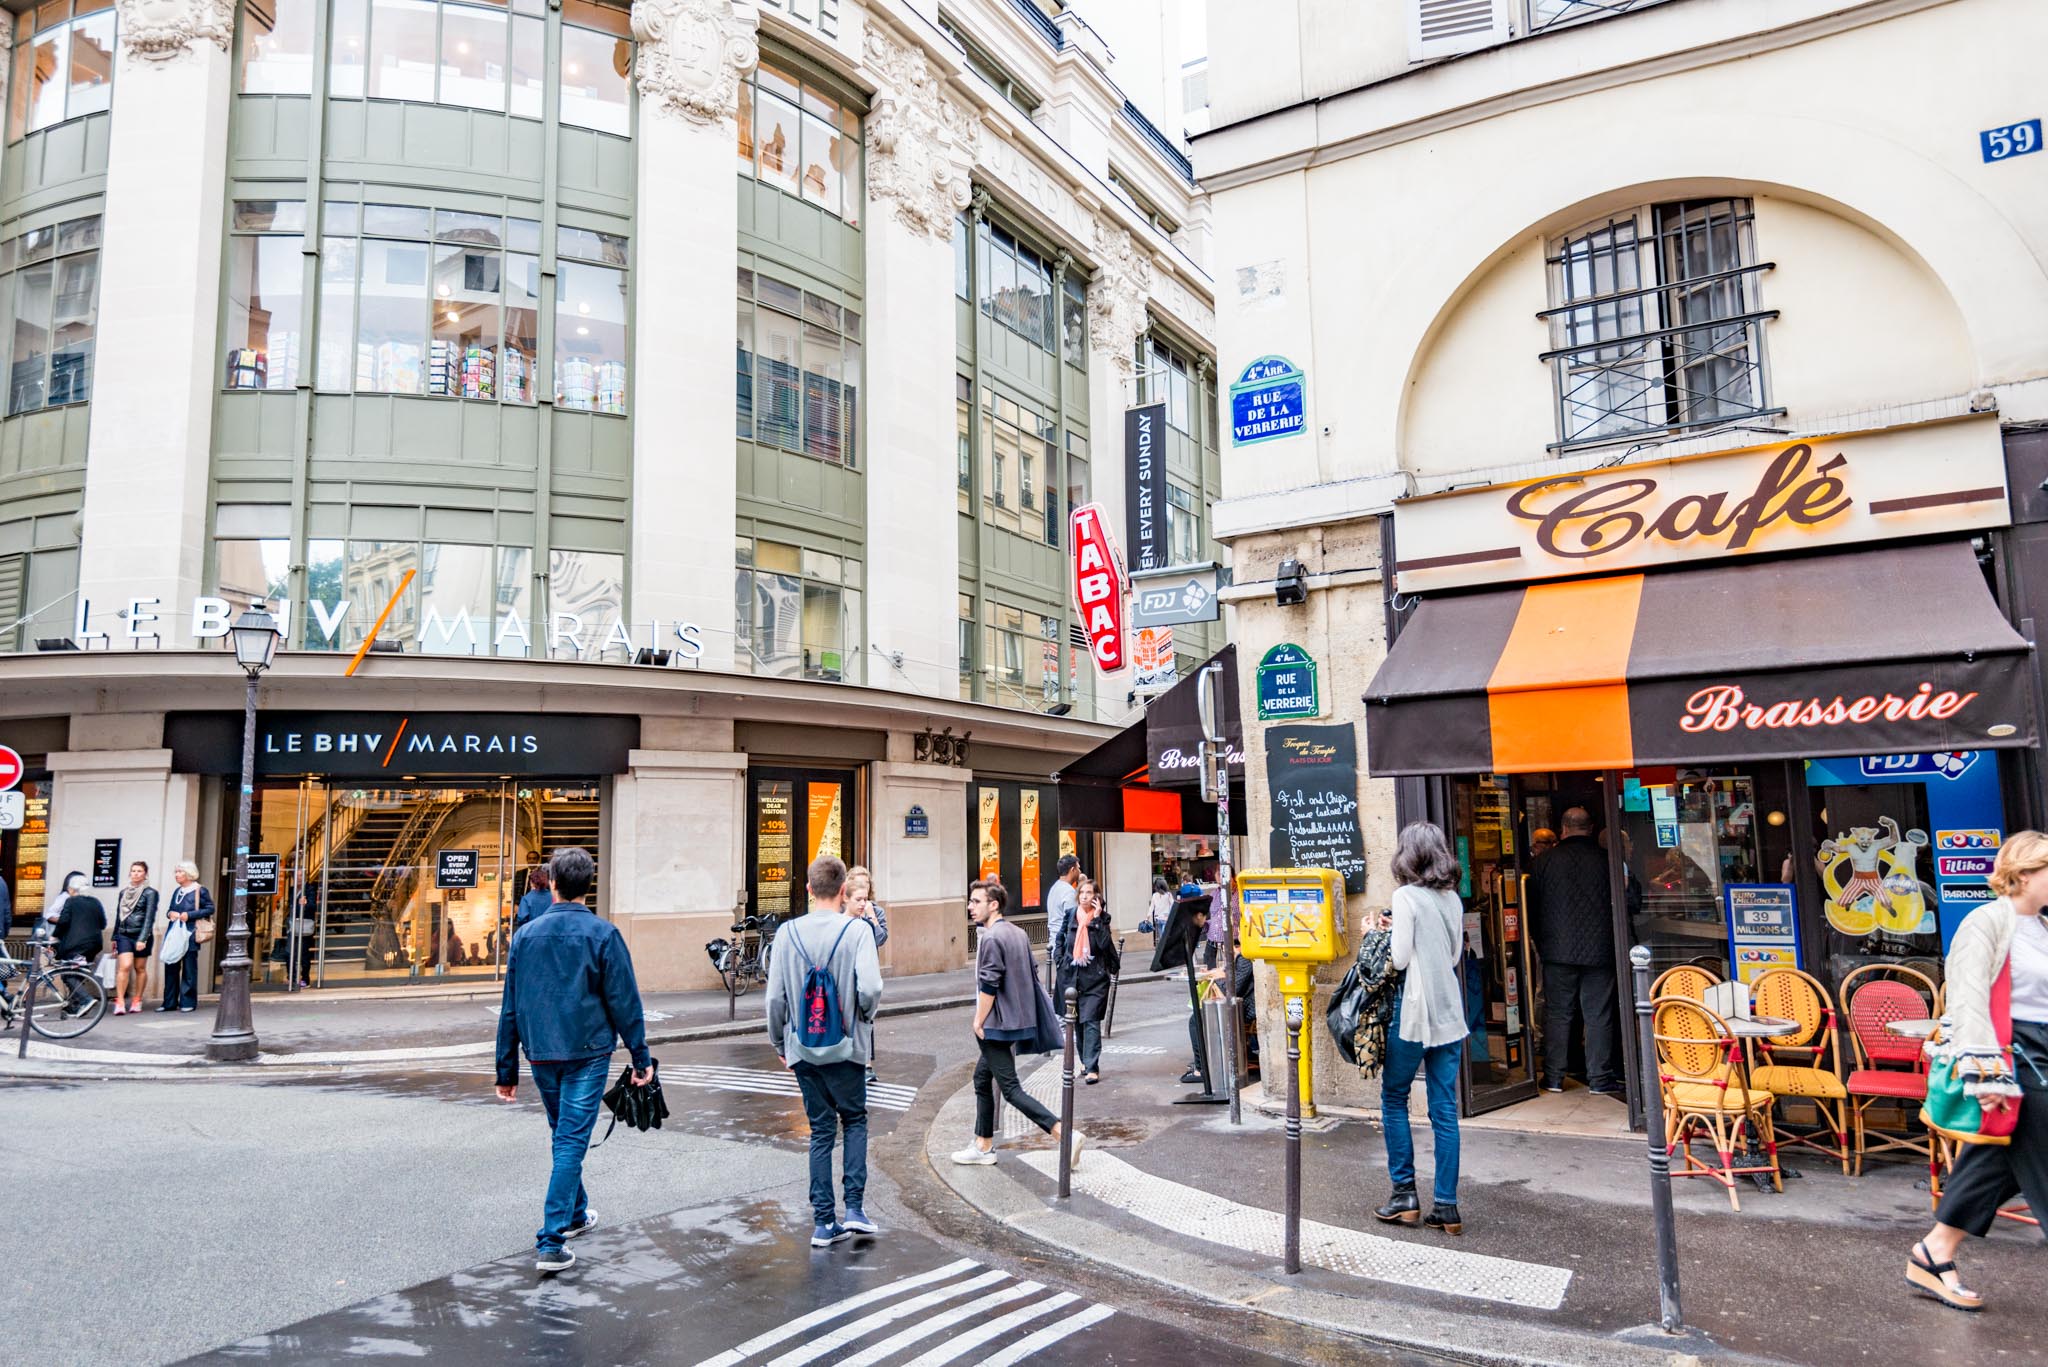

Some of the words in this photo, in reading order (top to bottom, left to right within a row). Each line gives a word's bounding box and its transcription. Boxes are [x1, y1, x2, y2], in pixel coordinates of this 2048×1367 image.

[1989, 125, 2034, 158] 59
[1253, 391, 1282, 407] RUE
[1248, 408, 1266, 421] DE
[1270, 404, 1289, 417] LA
[1235, 415, 1303, 437] VERRERIE
[1139, 414, 1152, 480] SUNDAY
[1506, 443, 1854, 559] Café
[1141, 485, 1152, 541] EVERY
[1141, 545, 1153, 571] EN
[1076, 512, 1117, 662] TABAC
[1144, 592, 1176, 610] FDJ
[77, 597, 160, 638] LE
[417, 604, 705, 658] MARAIS
[1276, 673, 1297, 685] RUE
[1263, 696, 1312, 710] VERRERIE
[1680, 682, 1979, 733] Brasserie
[266, 734, 302, 752] LE
[407, 735, 538, 753] MARAIS
[1868, 754, 1920, 769] FDJ
[1946, 860, 1986, 873] illiko
[1944, 890, 1987, 899] PARIONS
[1752, 911, 1769, 922] 39
[1736, 926, 1780, 935] MILLIONS
